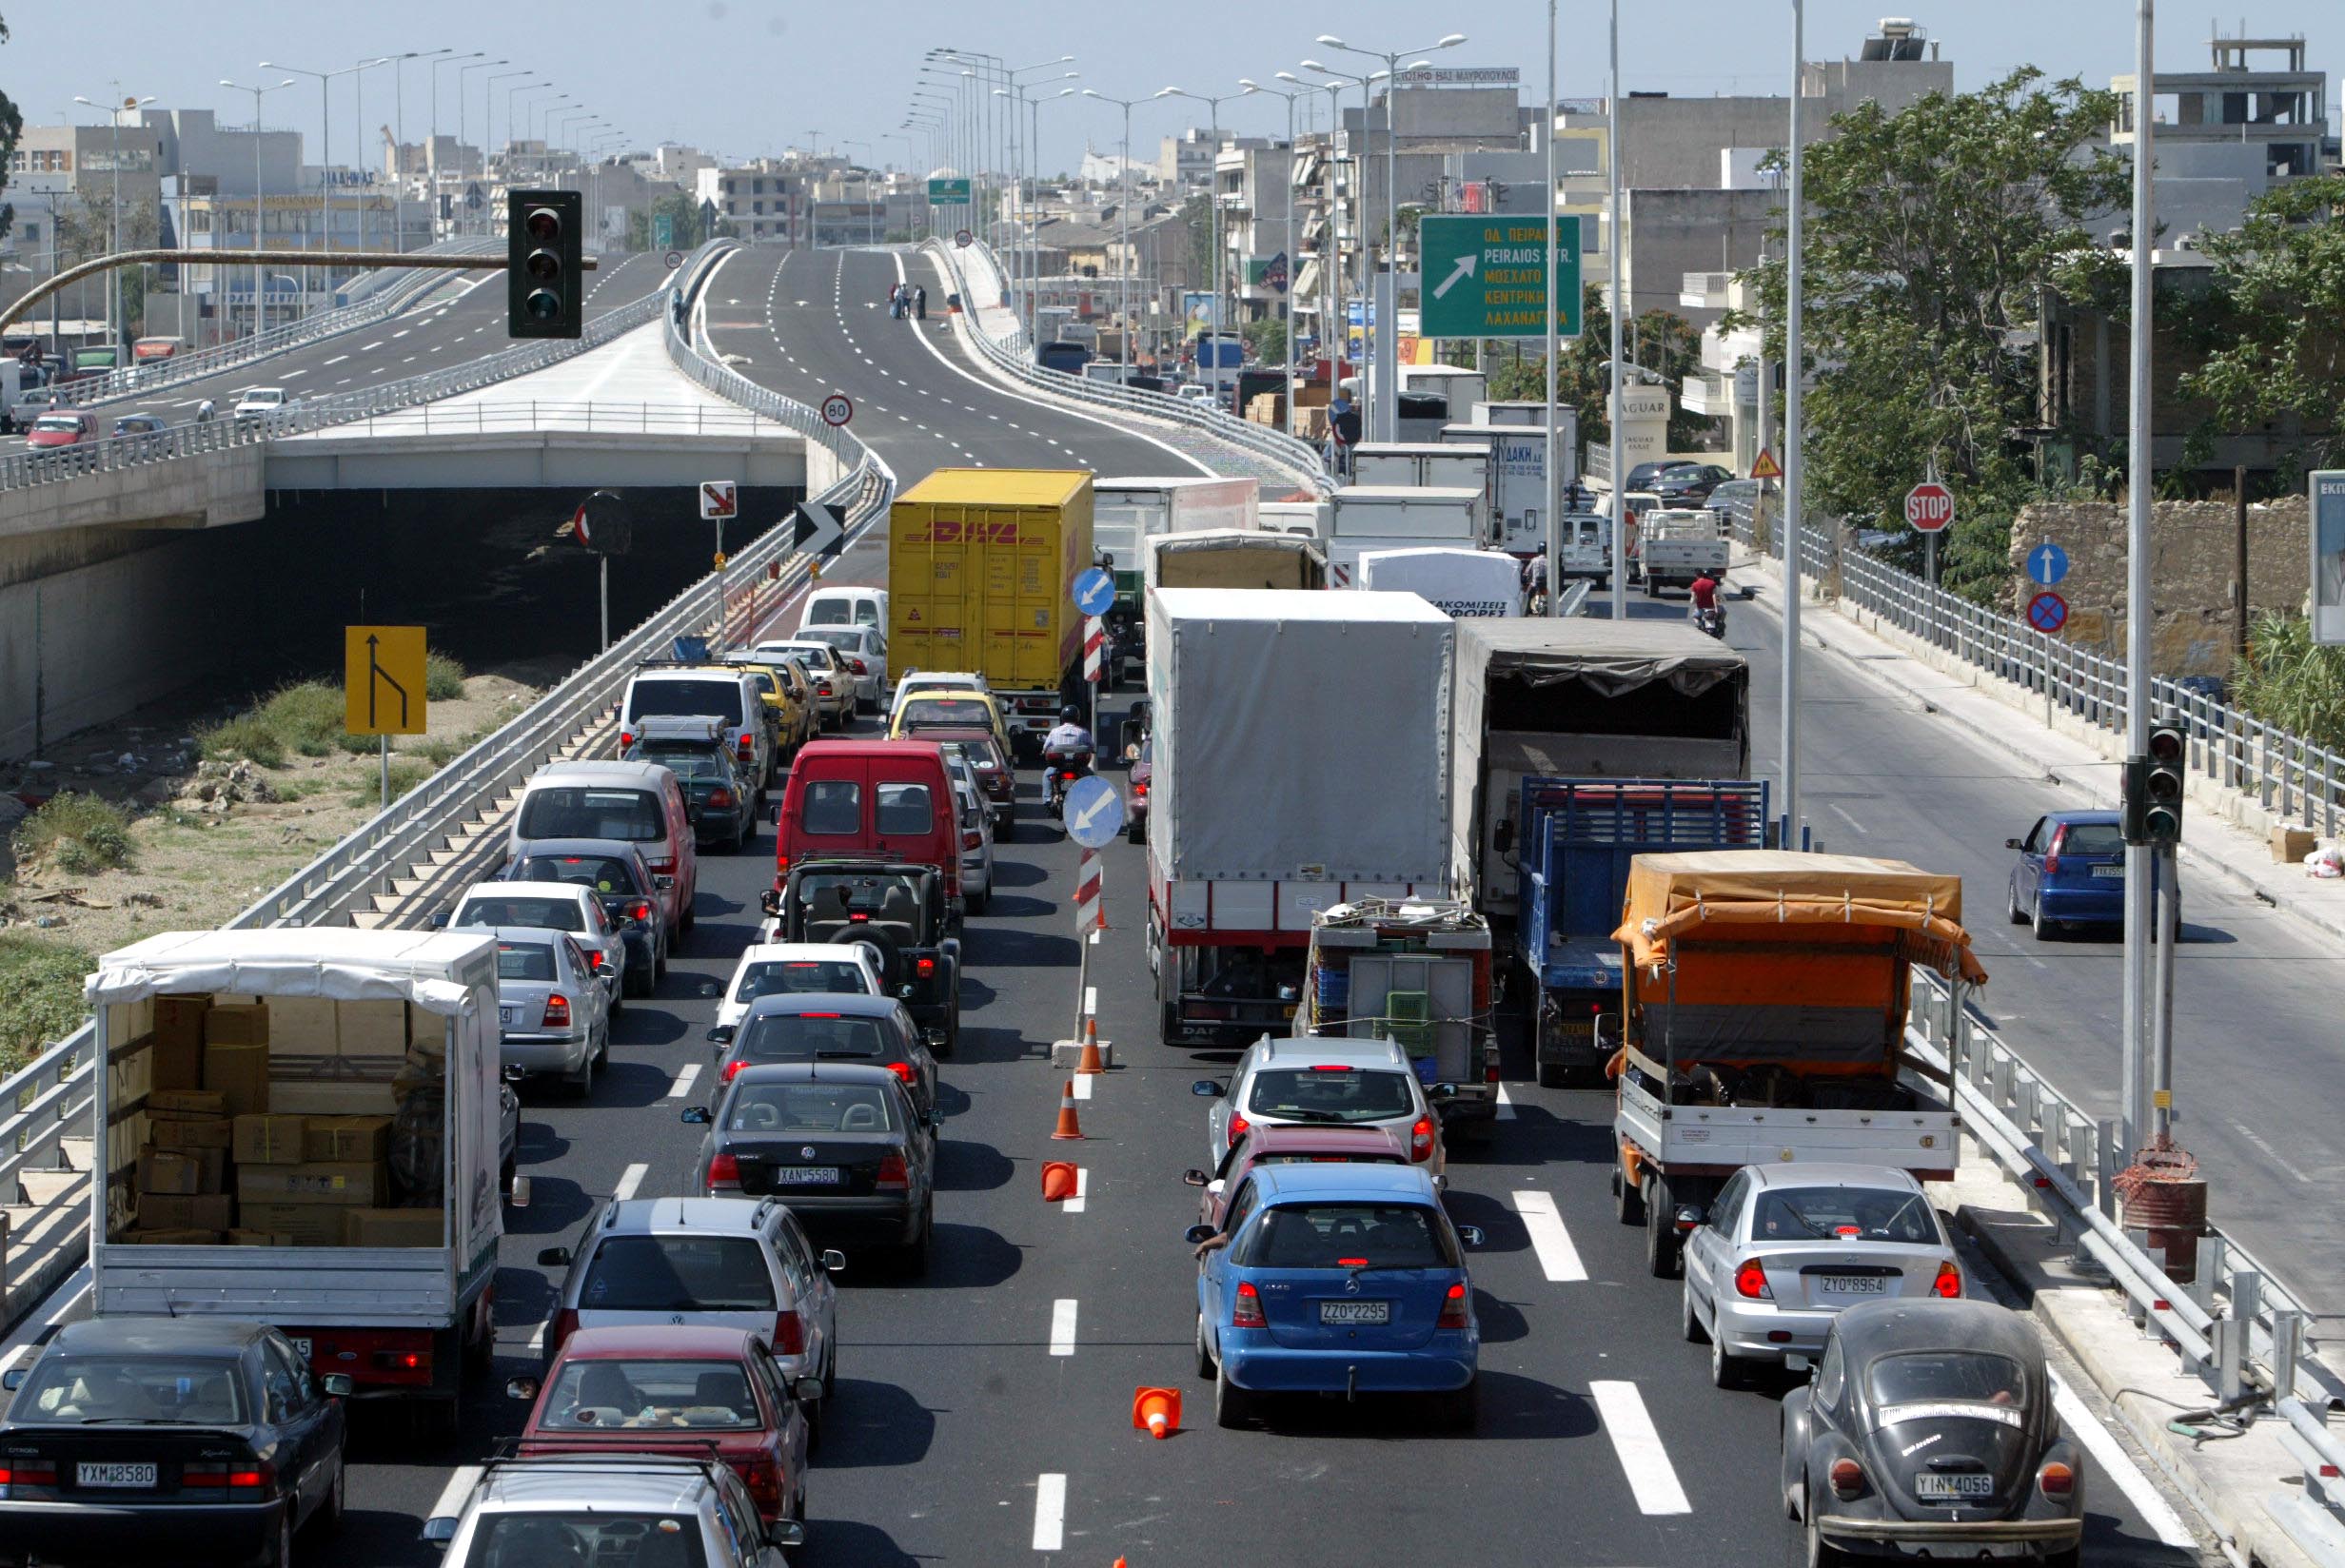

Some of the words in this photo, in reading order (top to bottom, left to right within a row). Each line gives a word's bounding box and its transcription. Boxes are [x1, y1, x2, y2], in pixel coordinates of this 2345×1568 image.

[1485, 248, 1540, 263] PEIRAIOS
[1485, 269, 1541, 284] ΜΟΣΧΑΤΟ
[1486, 290, 1545, 304] ΚΕΝΤΡΙΚΗ
[829, 404, 845, 417] 80
[1909, 496, 1949, 519] STOP
[924, 522, 1021, 543] DHL
[1182, 1027, 1219, 1035] DAF
